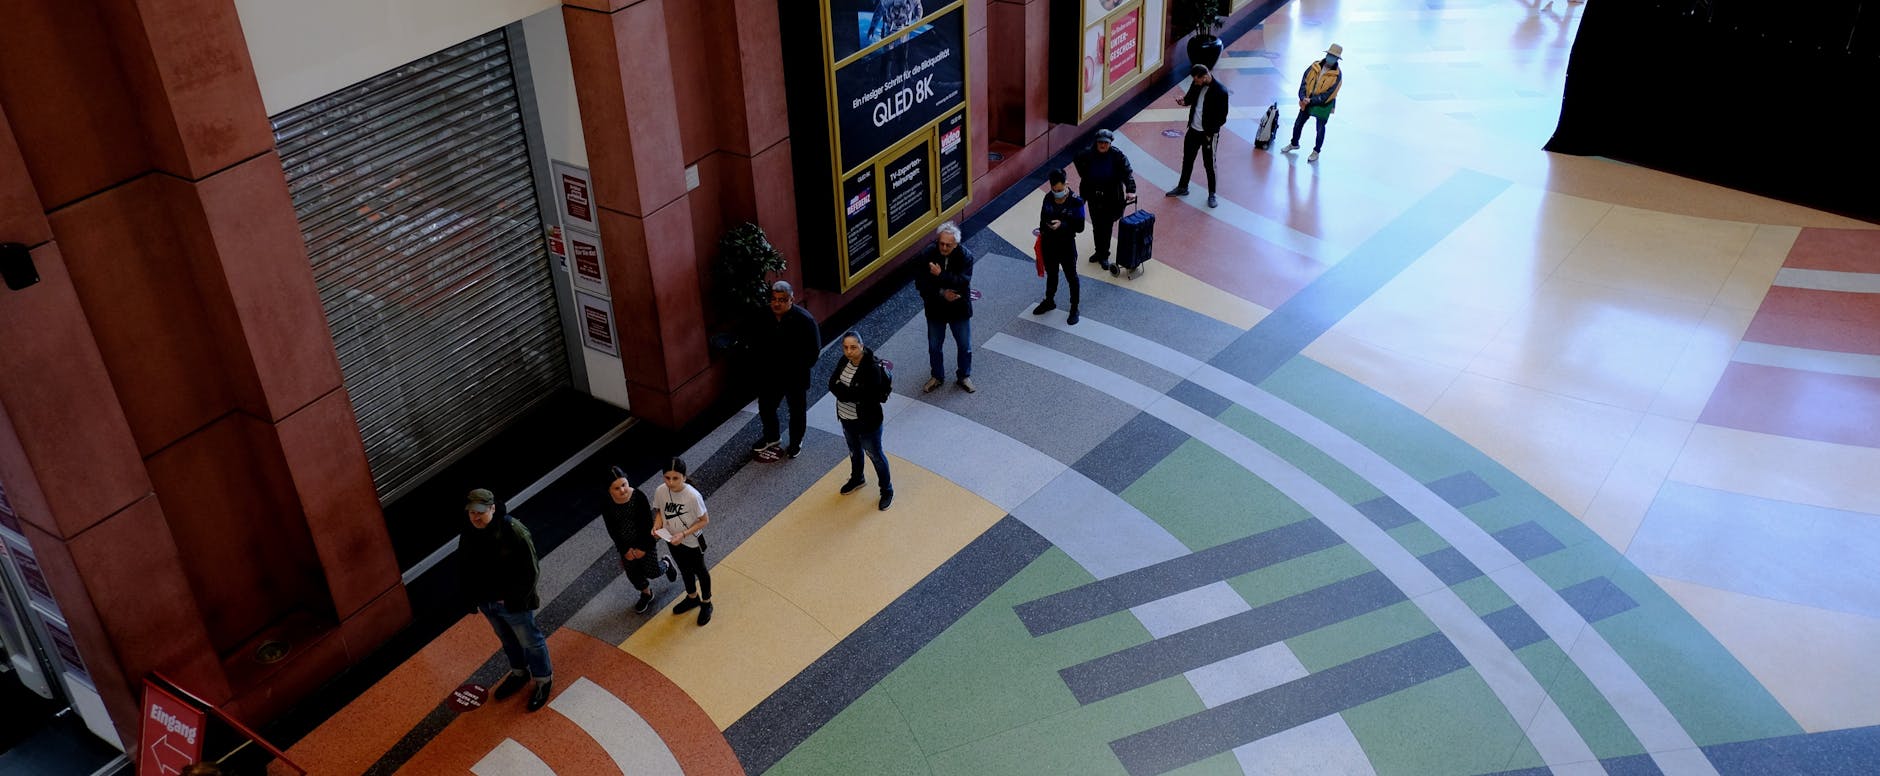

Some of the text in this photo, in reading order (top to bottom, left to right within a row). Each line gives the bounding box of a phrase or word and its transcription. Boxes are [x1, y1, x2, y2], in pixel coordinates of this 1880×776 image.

[1110, 32, 1128, 48] UNTER-
[1110, 38, 1136, 60] GESCHOSS
[852, 47, 950, 109] Ein riesiger Schritt für die Bildqualität
[872, 87, 914, 127] QLED
[916, 74, 934, 104] 8K
[941, 128, 960, 147] video
[890, 158, 922, 181] TV-Experten-
[892, 168, 920, 190] Meinungen:
[846, 192, 870, 213] REFERENZ
[664, 502, 684, 512] NIKE
[150, 704, 197, 745] Eingang
